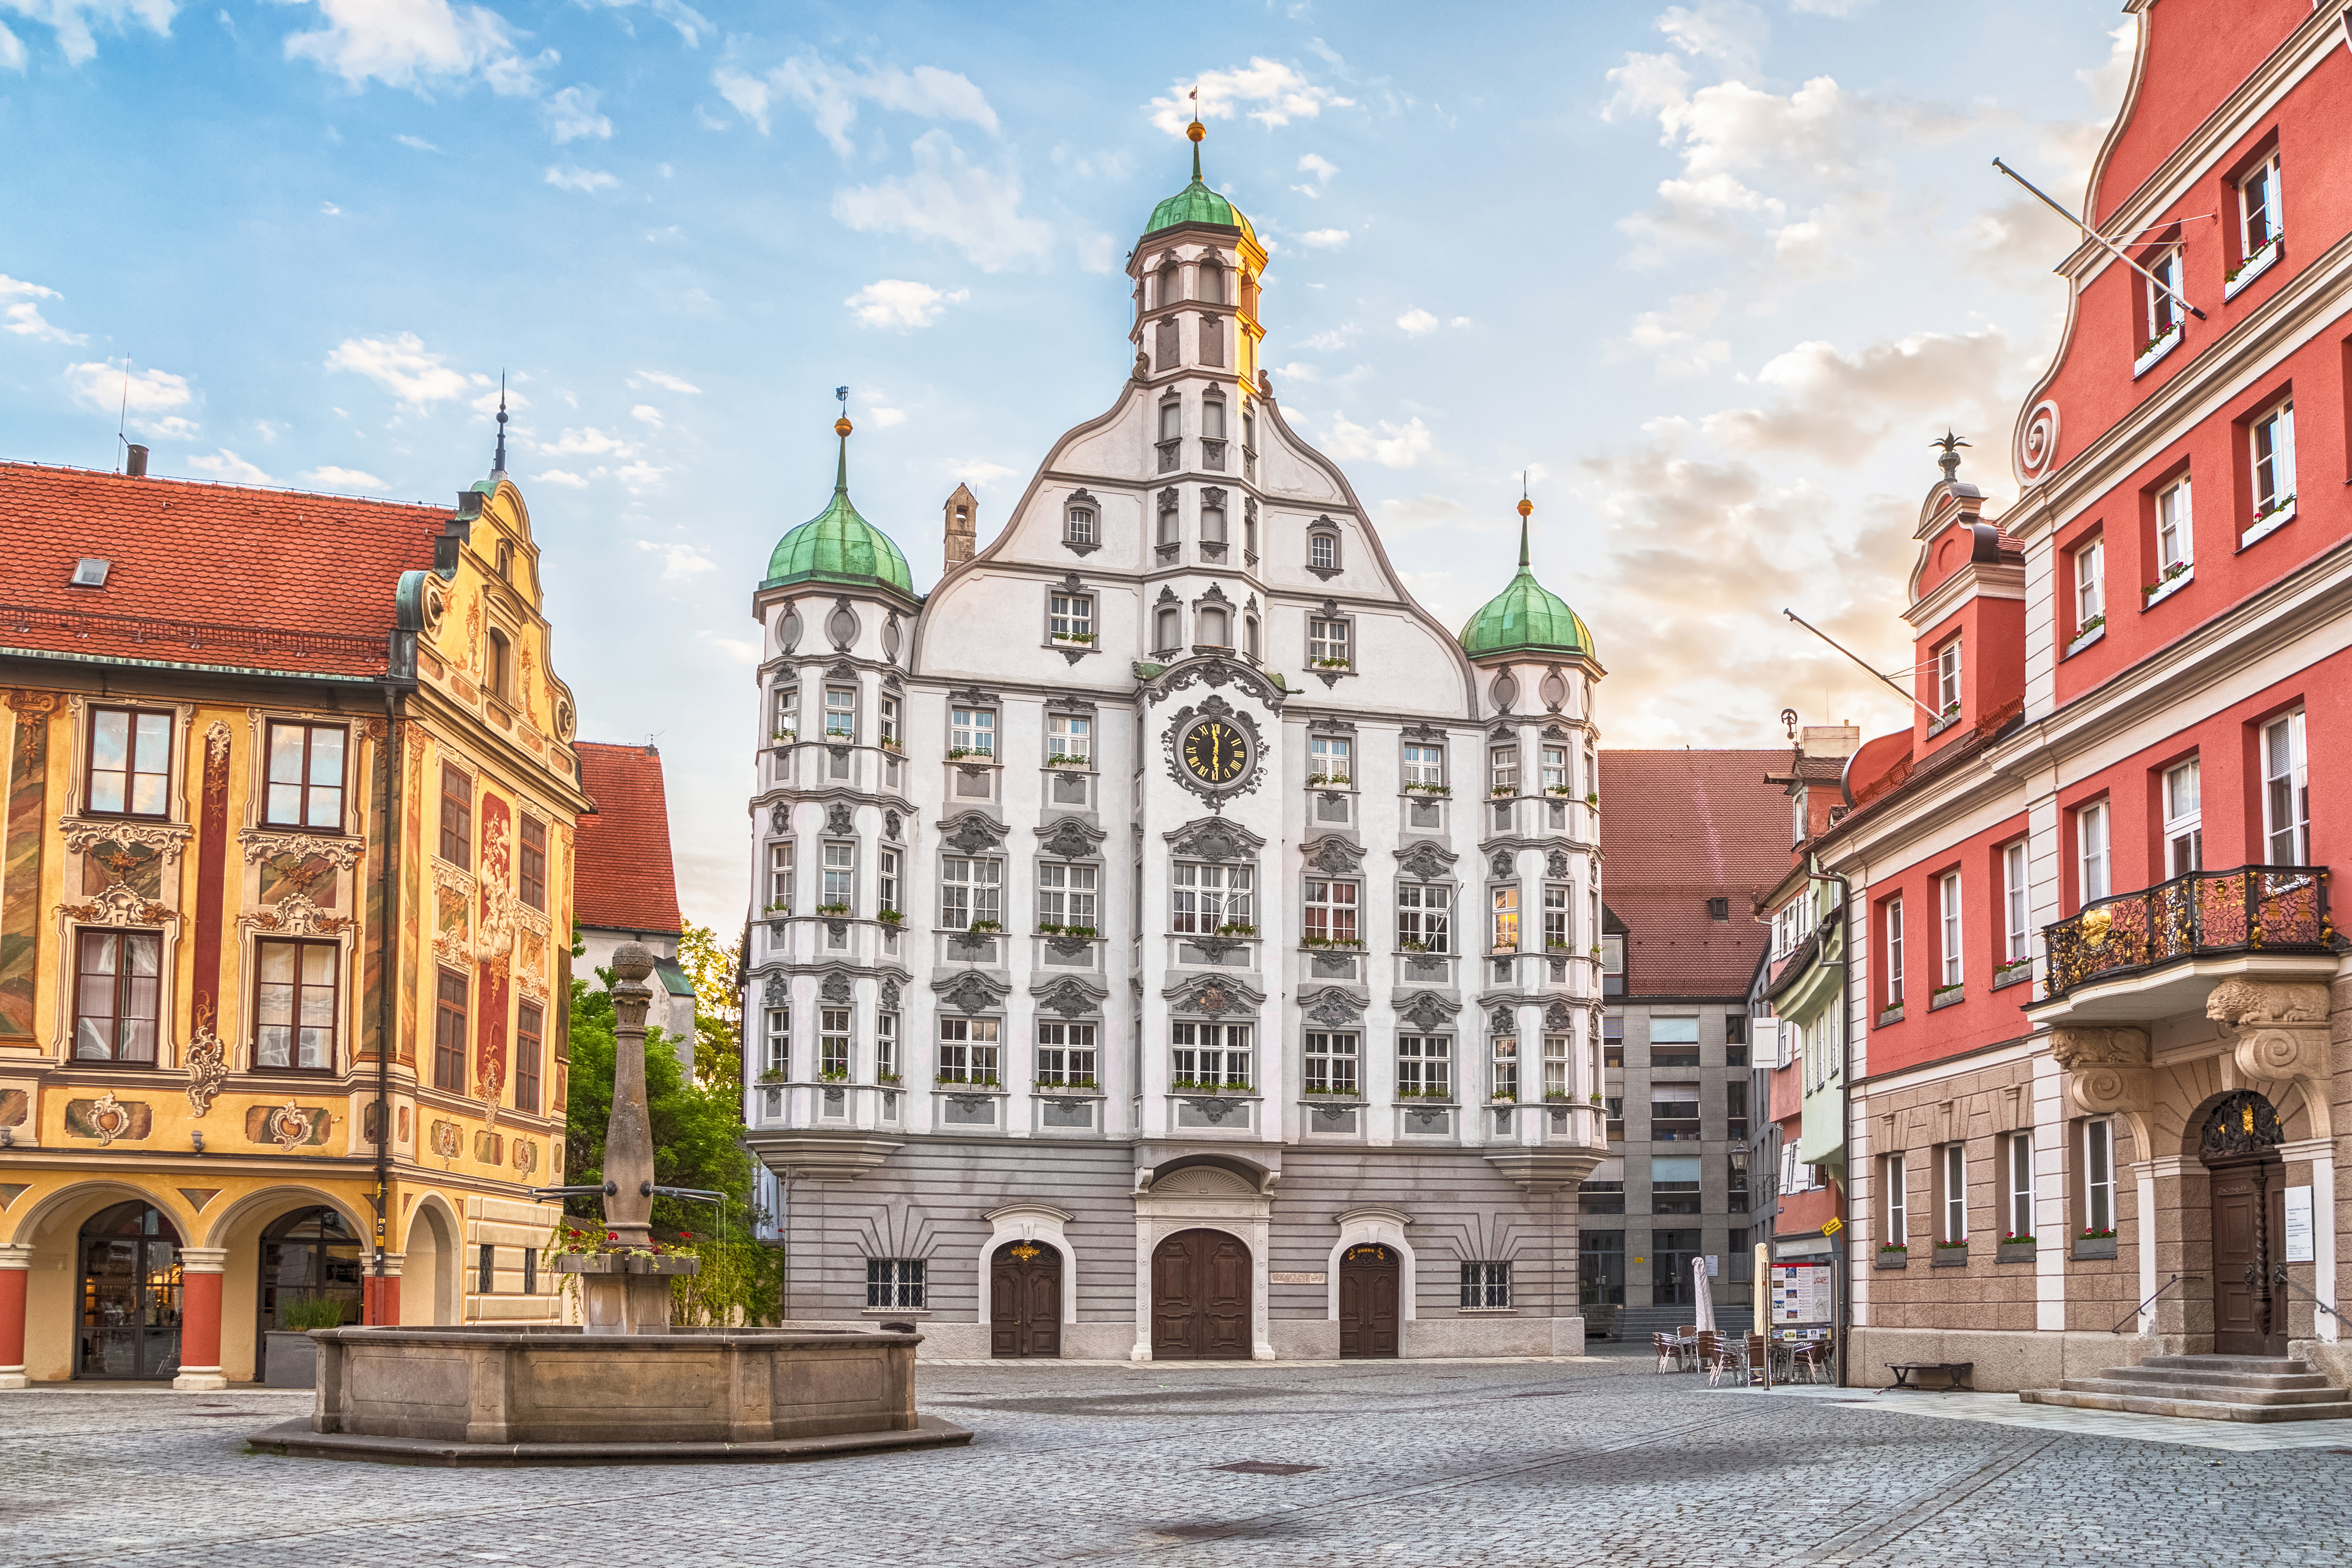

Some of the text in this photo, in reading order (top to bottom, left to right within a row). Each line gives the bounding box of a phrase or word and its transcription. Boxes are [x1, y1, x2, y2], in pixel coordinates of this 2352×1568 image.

[1199, 725, 1208, 736] XI
[1224, 729, 1231, 737] I
[1189, 734, 1200, 744] X
[1230, 760, 1242, 771] IIII
